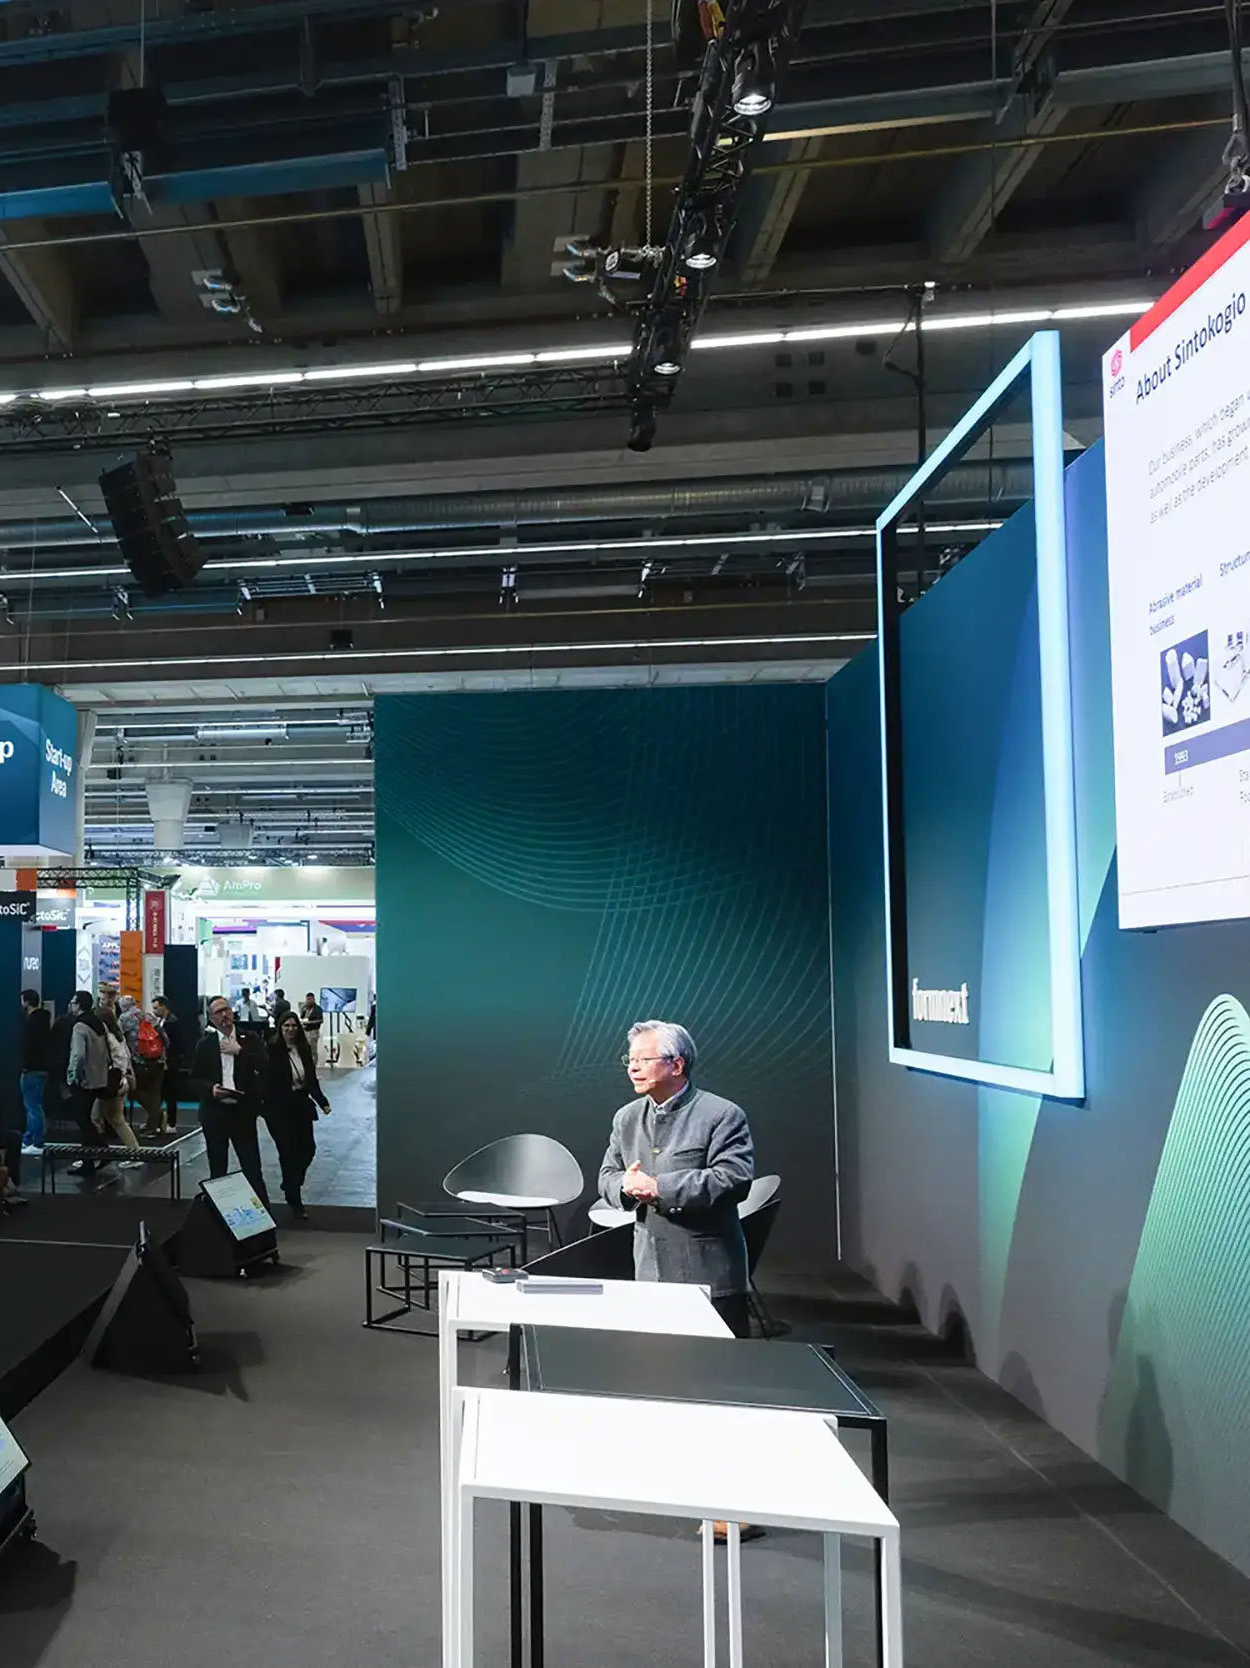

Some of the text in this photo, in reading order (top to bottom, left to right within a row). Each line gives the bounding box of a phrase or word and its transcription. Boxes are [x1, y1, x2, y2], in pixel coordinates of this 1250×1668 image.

[1136, 292, 1247, 405] About Sintokogio
[45, 738, 73, 777] Start-up
[50, 770, 68, 798] Area
